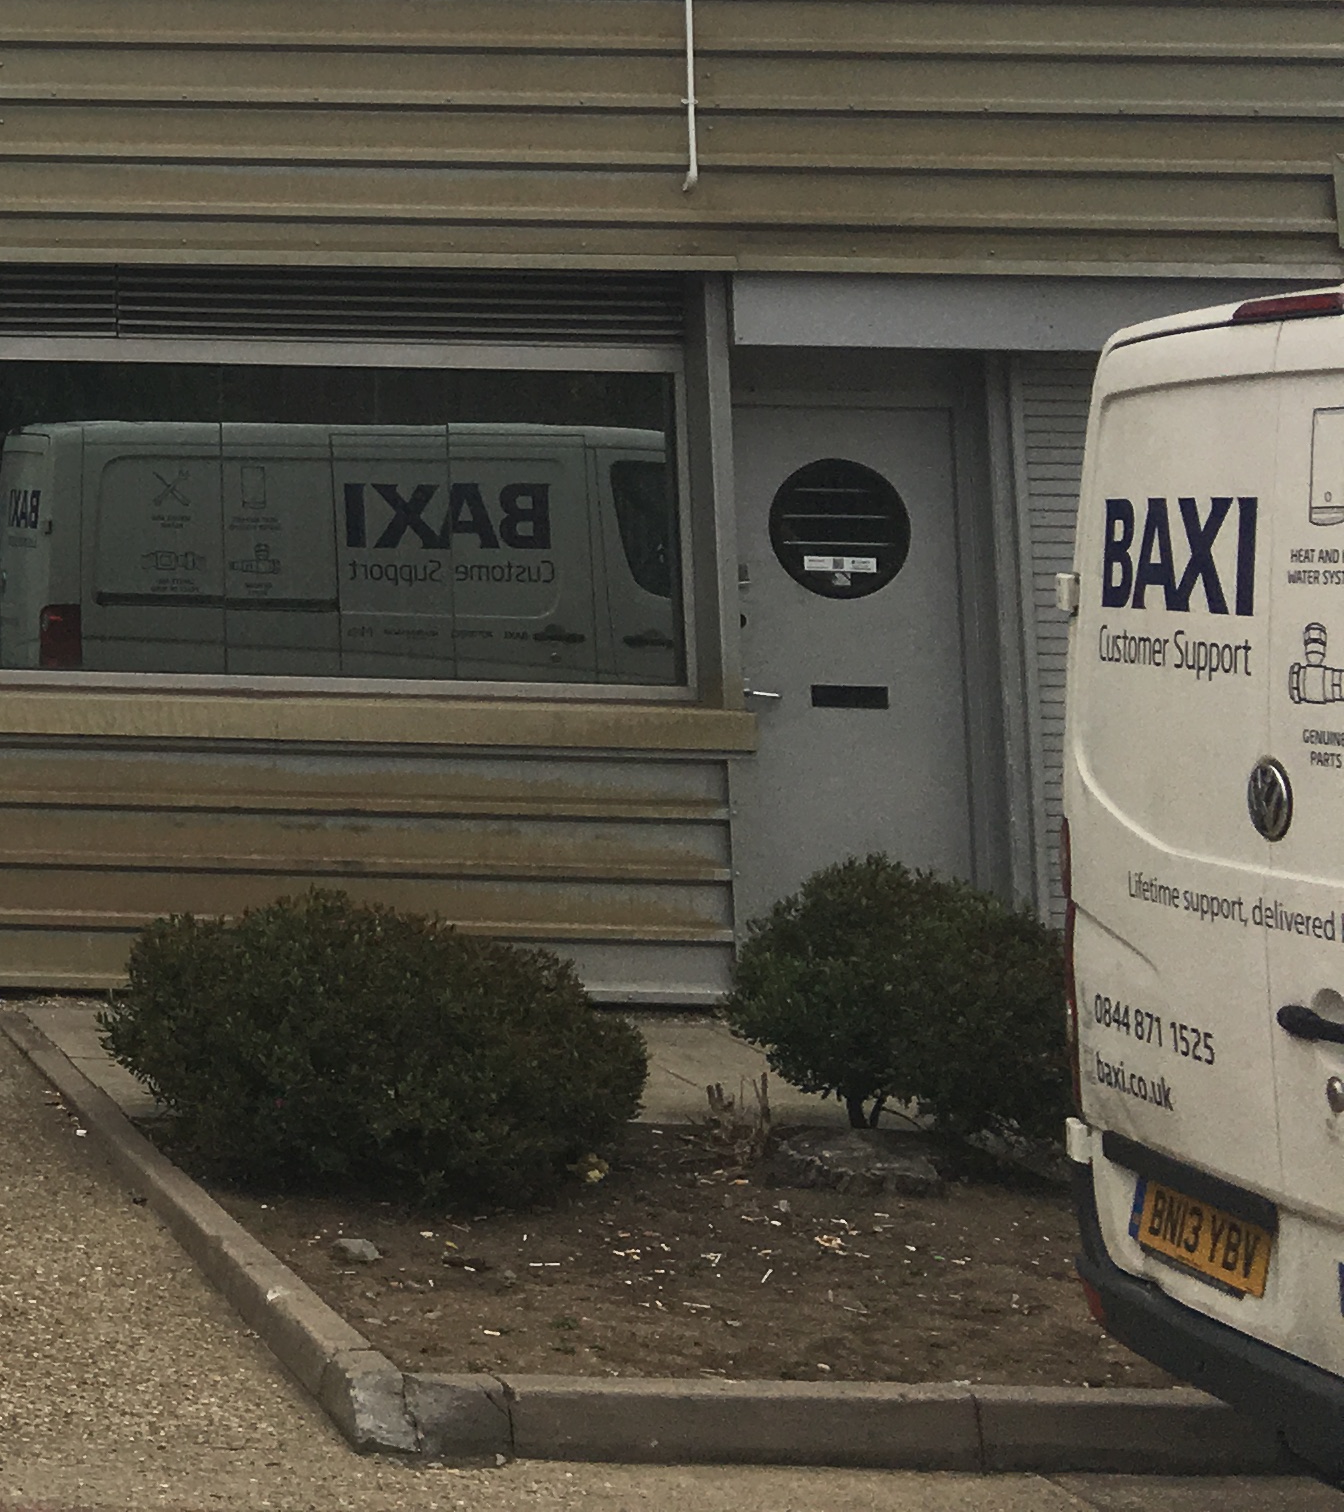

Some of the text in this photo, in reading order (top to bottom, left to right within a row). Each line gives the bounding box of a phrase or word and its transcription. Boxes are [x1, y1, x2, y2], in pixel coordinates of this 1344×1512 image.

[1102, 497, 1258, 616] BAXI
[1288, 570, 1320, 585] WATER
[1291, 548, 1314, 564] HEAT
[1318, 550, 1340, 564] AND
[1099, 624, 1252, 682] Customer Support
[1310, 750, 1342, 768] PARTS
[1128, 871, 1179, 908] Lifetime
[1184, 889, 1248, 927] support,
[1252, 897, 1335, 941] delivered
[1095, 992, 1215, 1065] 0844 871 1525
[1096, 1051, 1174, 1111] baxi.co.uk
[1148, 1189, 1262, 1279] BN13 YBV
